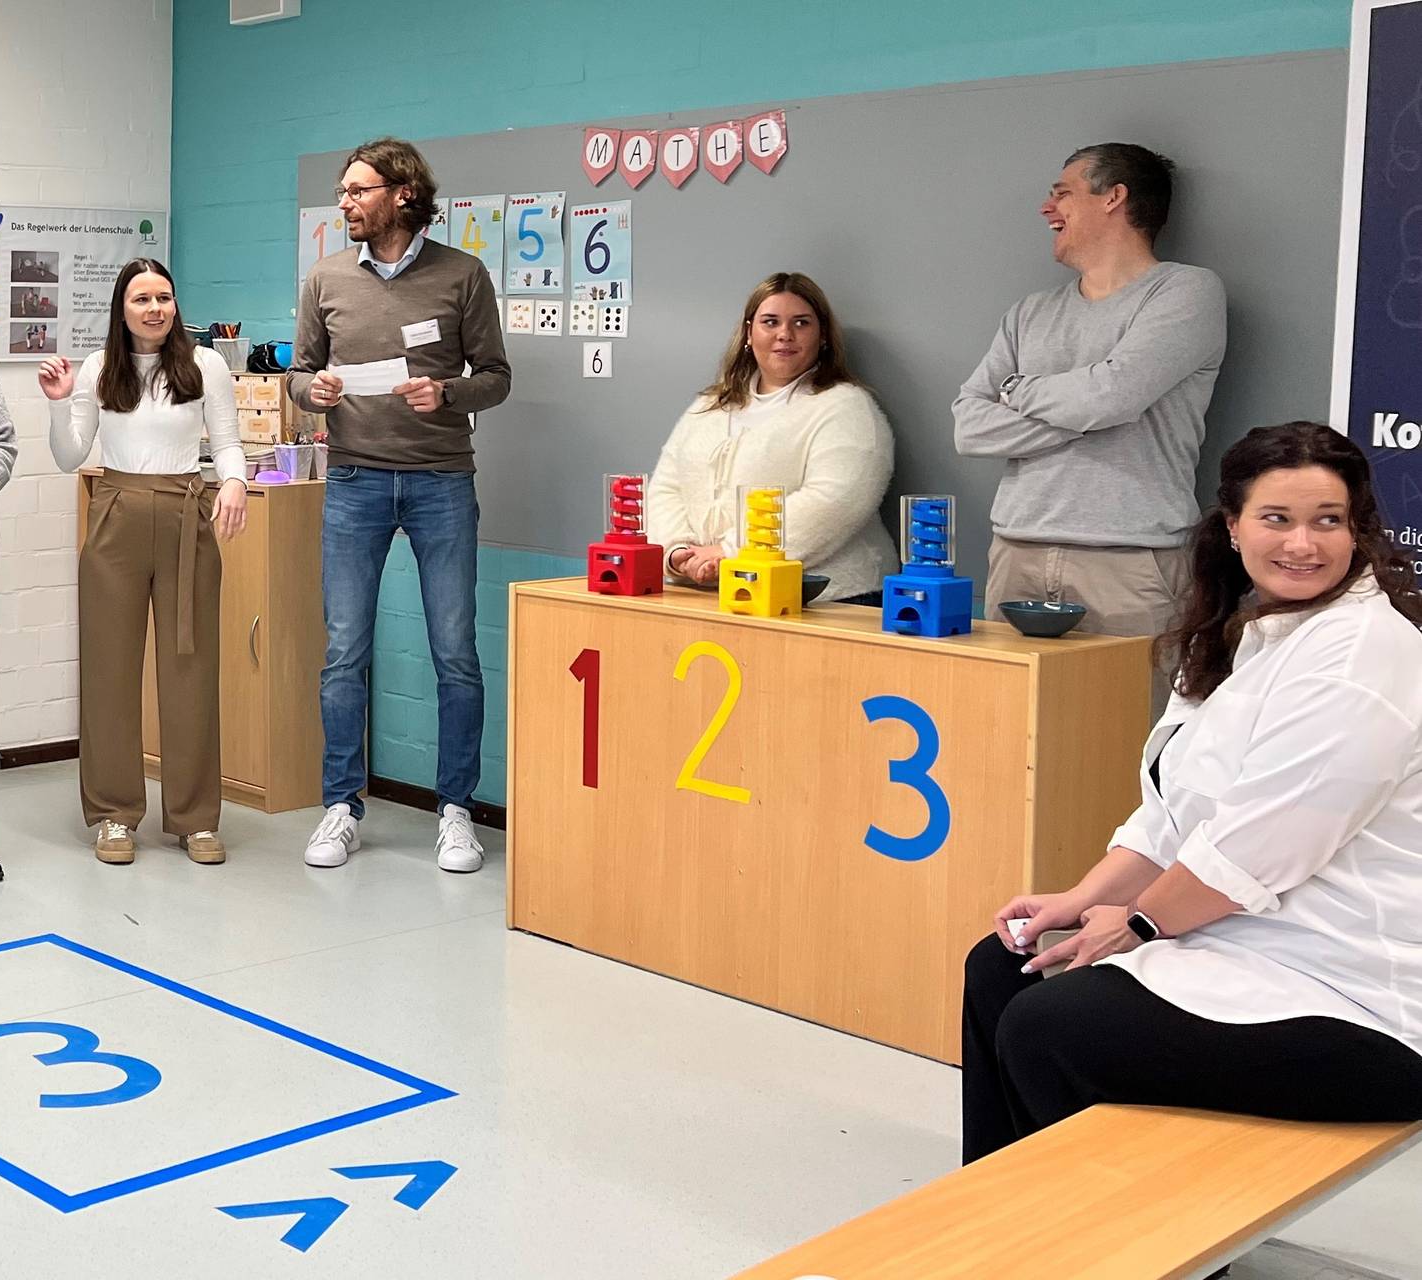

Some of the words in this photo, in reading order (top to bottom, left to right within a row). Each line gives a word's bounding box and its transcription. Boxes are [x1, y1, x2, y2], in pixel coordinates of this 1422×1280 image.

[589, 123, 770, 167] MATHE
[11, 222, 25, 231] Das
[27, 223, 68, 234] Regelwerk
[69, 224, 83, 233] der
[84, 225, 134, 235] Lindenschule
[313, 221, 327, 260] 1
[461, 211, 488, 258] 4
[518, 207, 545, 262] 5
[584, 219, 611, 275] 6
[592, 348, 603, 374] 6
[1372, 412, 1422, 450] Ko
[569, 648, 600, 789] 1
[672, 641, 752, 805] 2
[861, 695, 952, 862] 3
